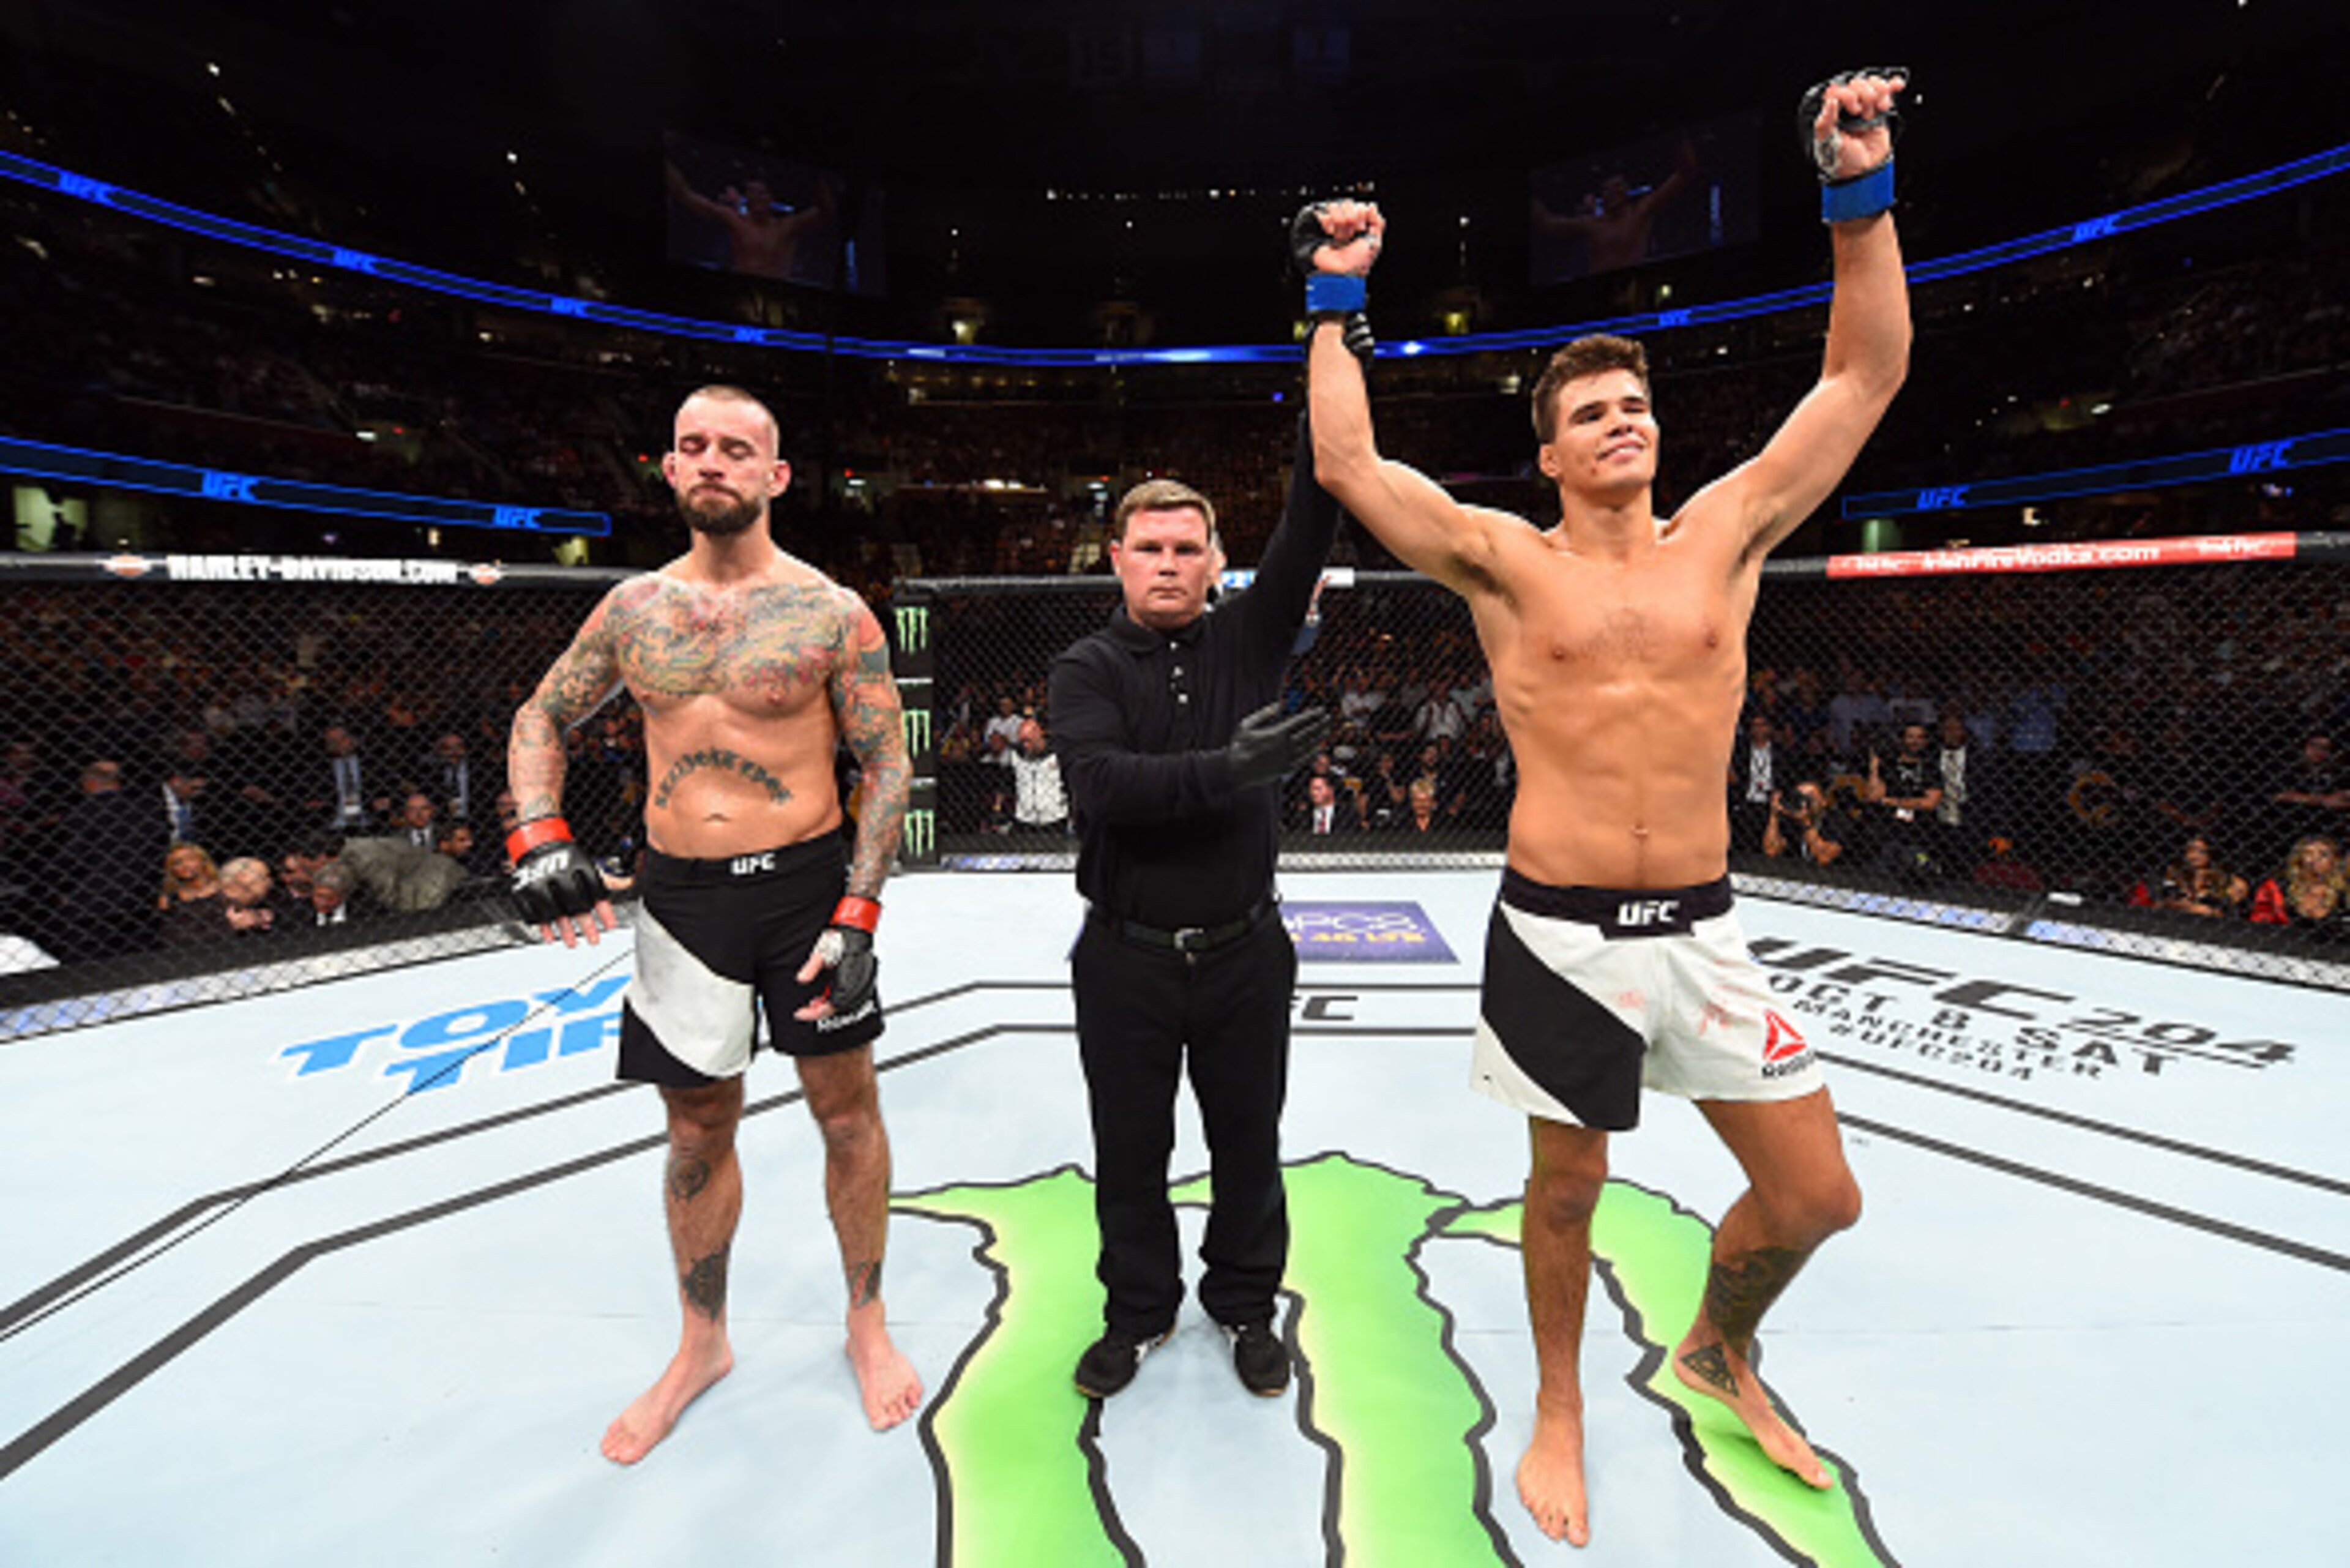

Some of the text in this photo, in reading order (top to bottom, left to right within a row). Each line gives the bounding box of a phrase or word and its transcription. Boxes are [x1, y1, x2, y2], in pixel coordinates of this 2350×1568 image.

[59, 170, 113, 206] UFC
[2073, 214, 2120, 242] UFC
[2230, 442, 2294, 474] UFC
[203, 471, 258, 502] UFC
[1917, 487, 1968, 509] UFC
[494, 507, 541, 528] UFC
[731, 853, 775, 875] UFC
[1618, 900, 1680, 925] UFC
[1747, 938, 2296, 1063] UFC 204
[1769, 976, 1897, 1014] OCT
[2015, 1026, 2180, 1075] SAT
[1793, 998, 2102, 1080] MANCHESTER
